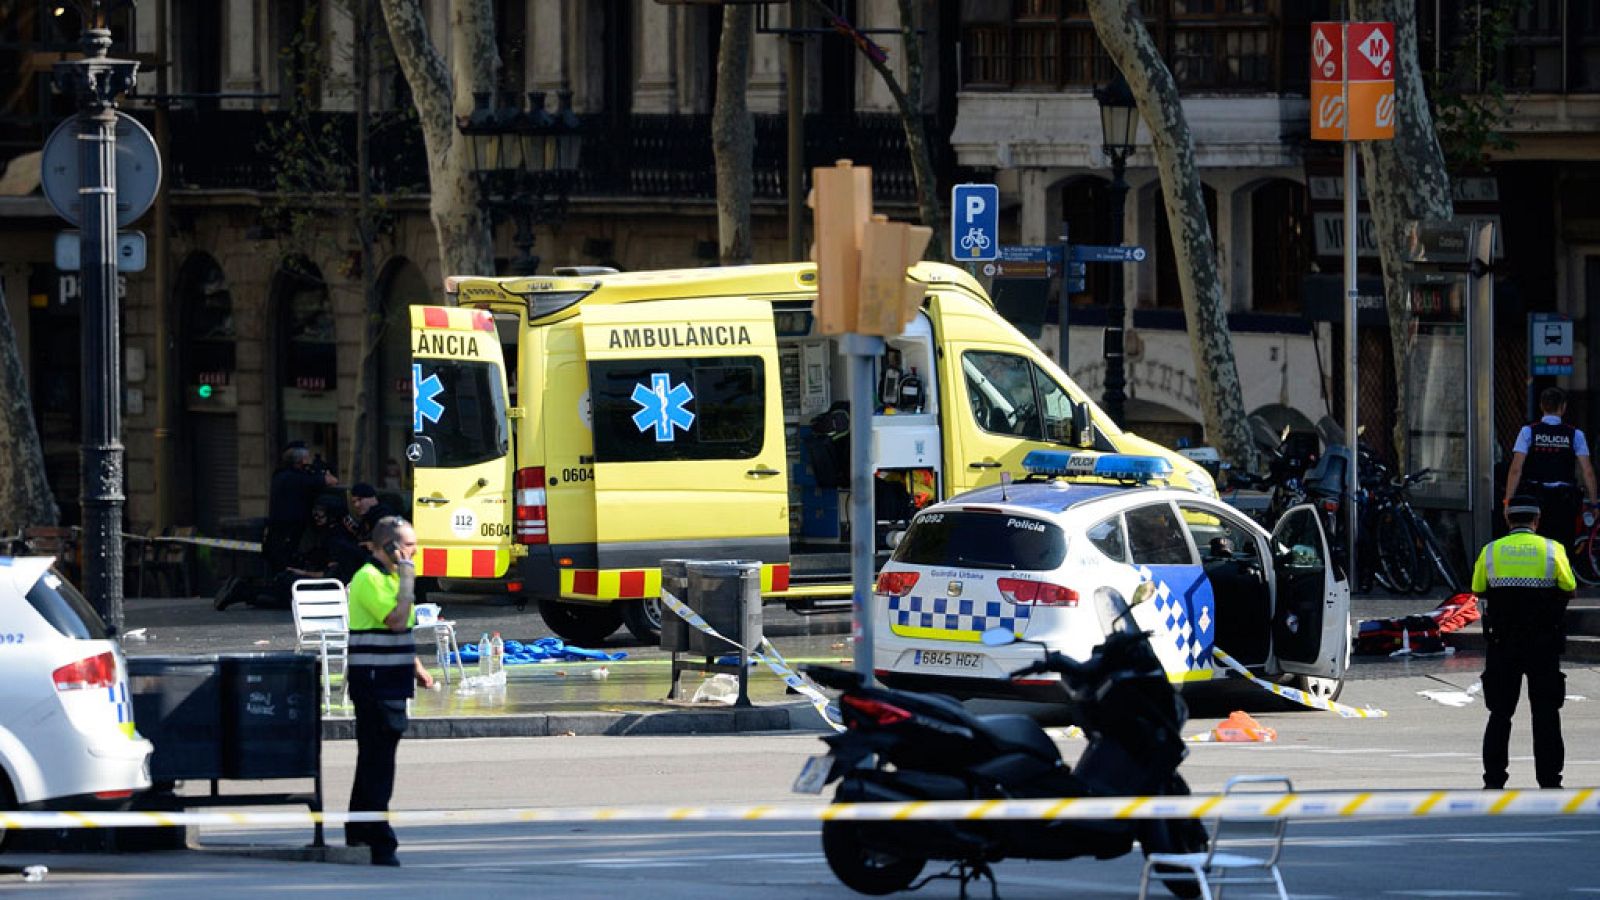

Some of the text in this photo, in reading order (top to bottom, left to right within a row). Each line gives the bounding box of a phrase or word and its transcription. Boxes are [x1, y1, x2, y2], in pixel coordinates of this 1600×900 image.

[1315, 38, 1325, 57] M
[1369, 38, 1383, 57] M
[966, 195, 985, 223] P
[608, 321, 752, 349] AMBULÀNCIA
[1535, 433, 1570, 443] POLICIA
[562, 468, 594, 482] 0604
[455, 515, 473, 526] 112
[480, 523, 510, 537] 0604
[922, 652, 981, 668] 6845 HGZ
